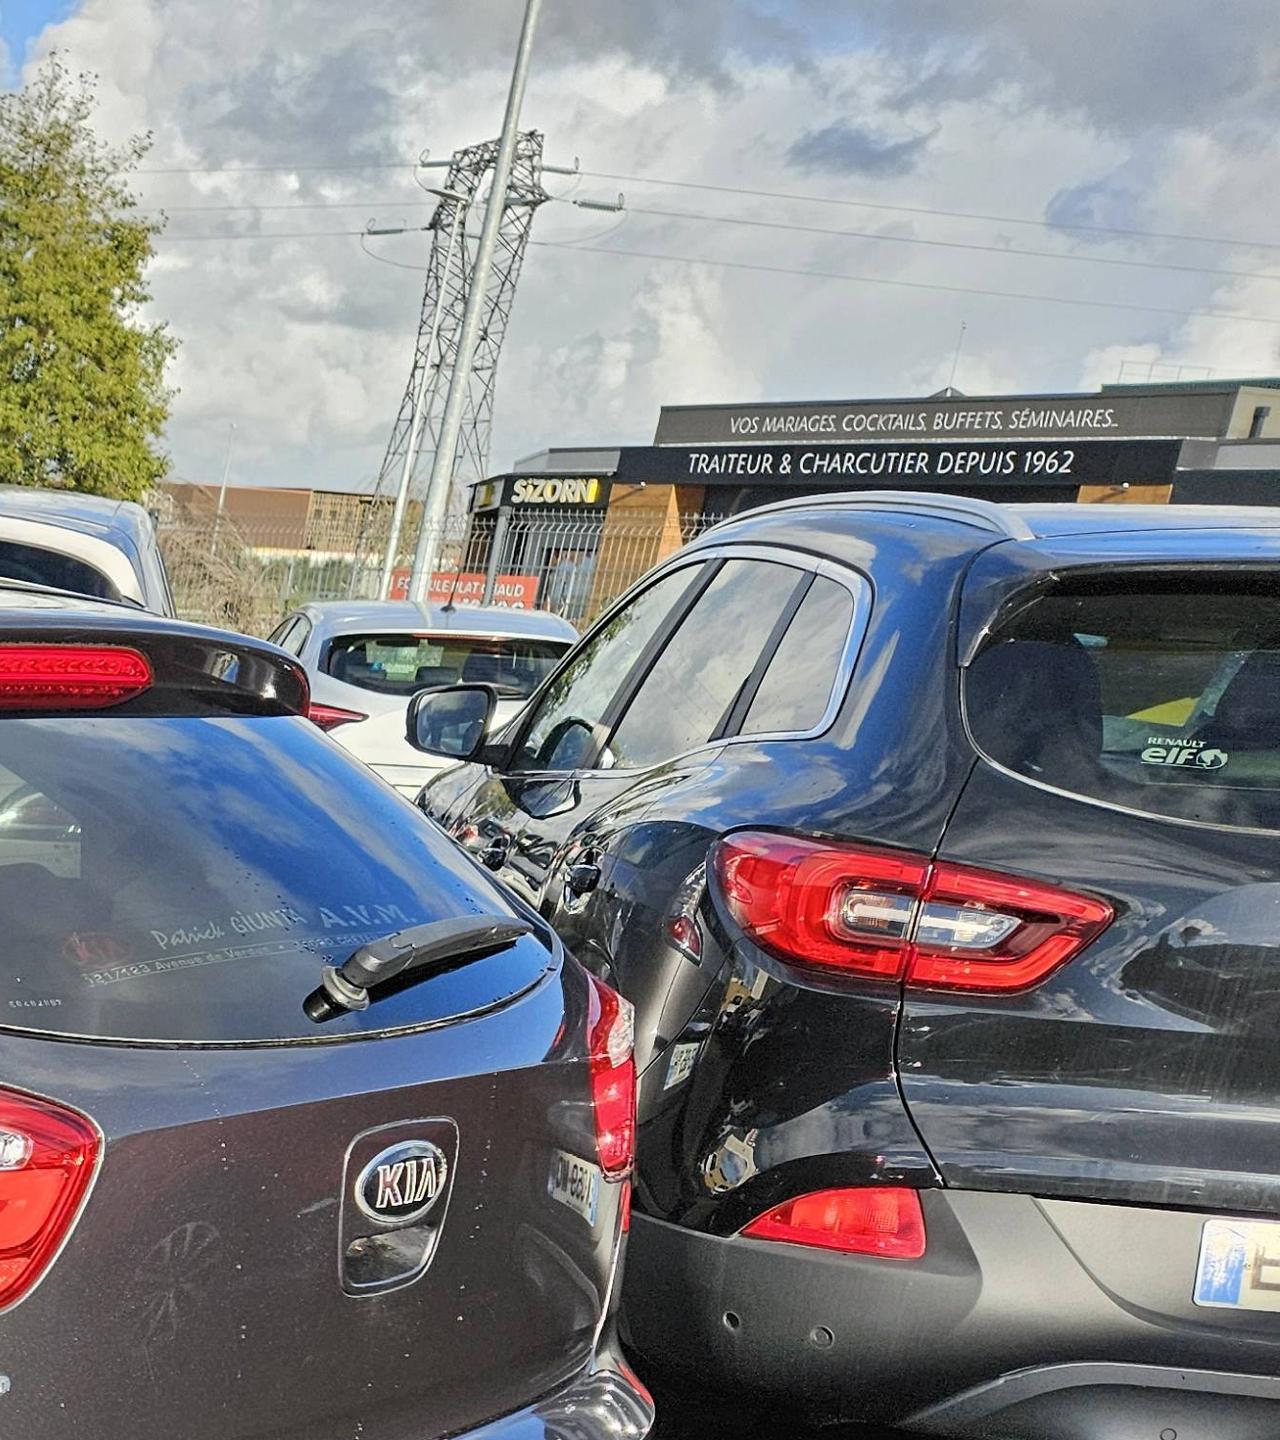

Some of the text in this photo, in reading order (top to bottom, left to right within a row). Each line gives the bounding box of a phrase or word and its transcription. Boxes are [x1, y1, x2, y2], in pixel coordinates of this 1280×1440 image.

[730, 416, 760, 434] VOS
[689, 450, 1075, 475] TRAITEUR & CHARCUTIER DEPUIS 1962
[1148, 736, 1208, 748] RENAULT
[1141, 747, 1198, 765] elf
[319, 904, 418, 929] A.V.M.
[375, 1157, 438, 1209] KIA
